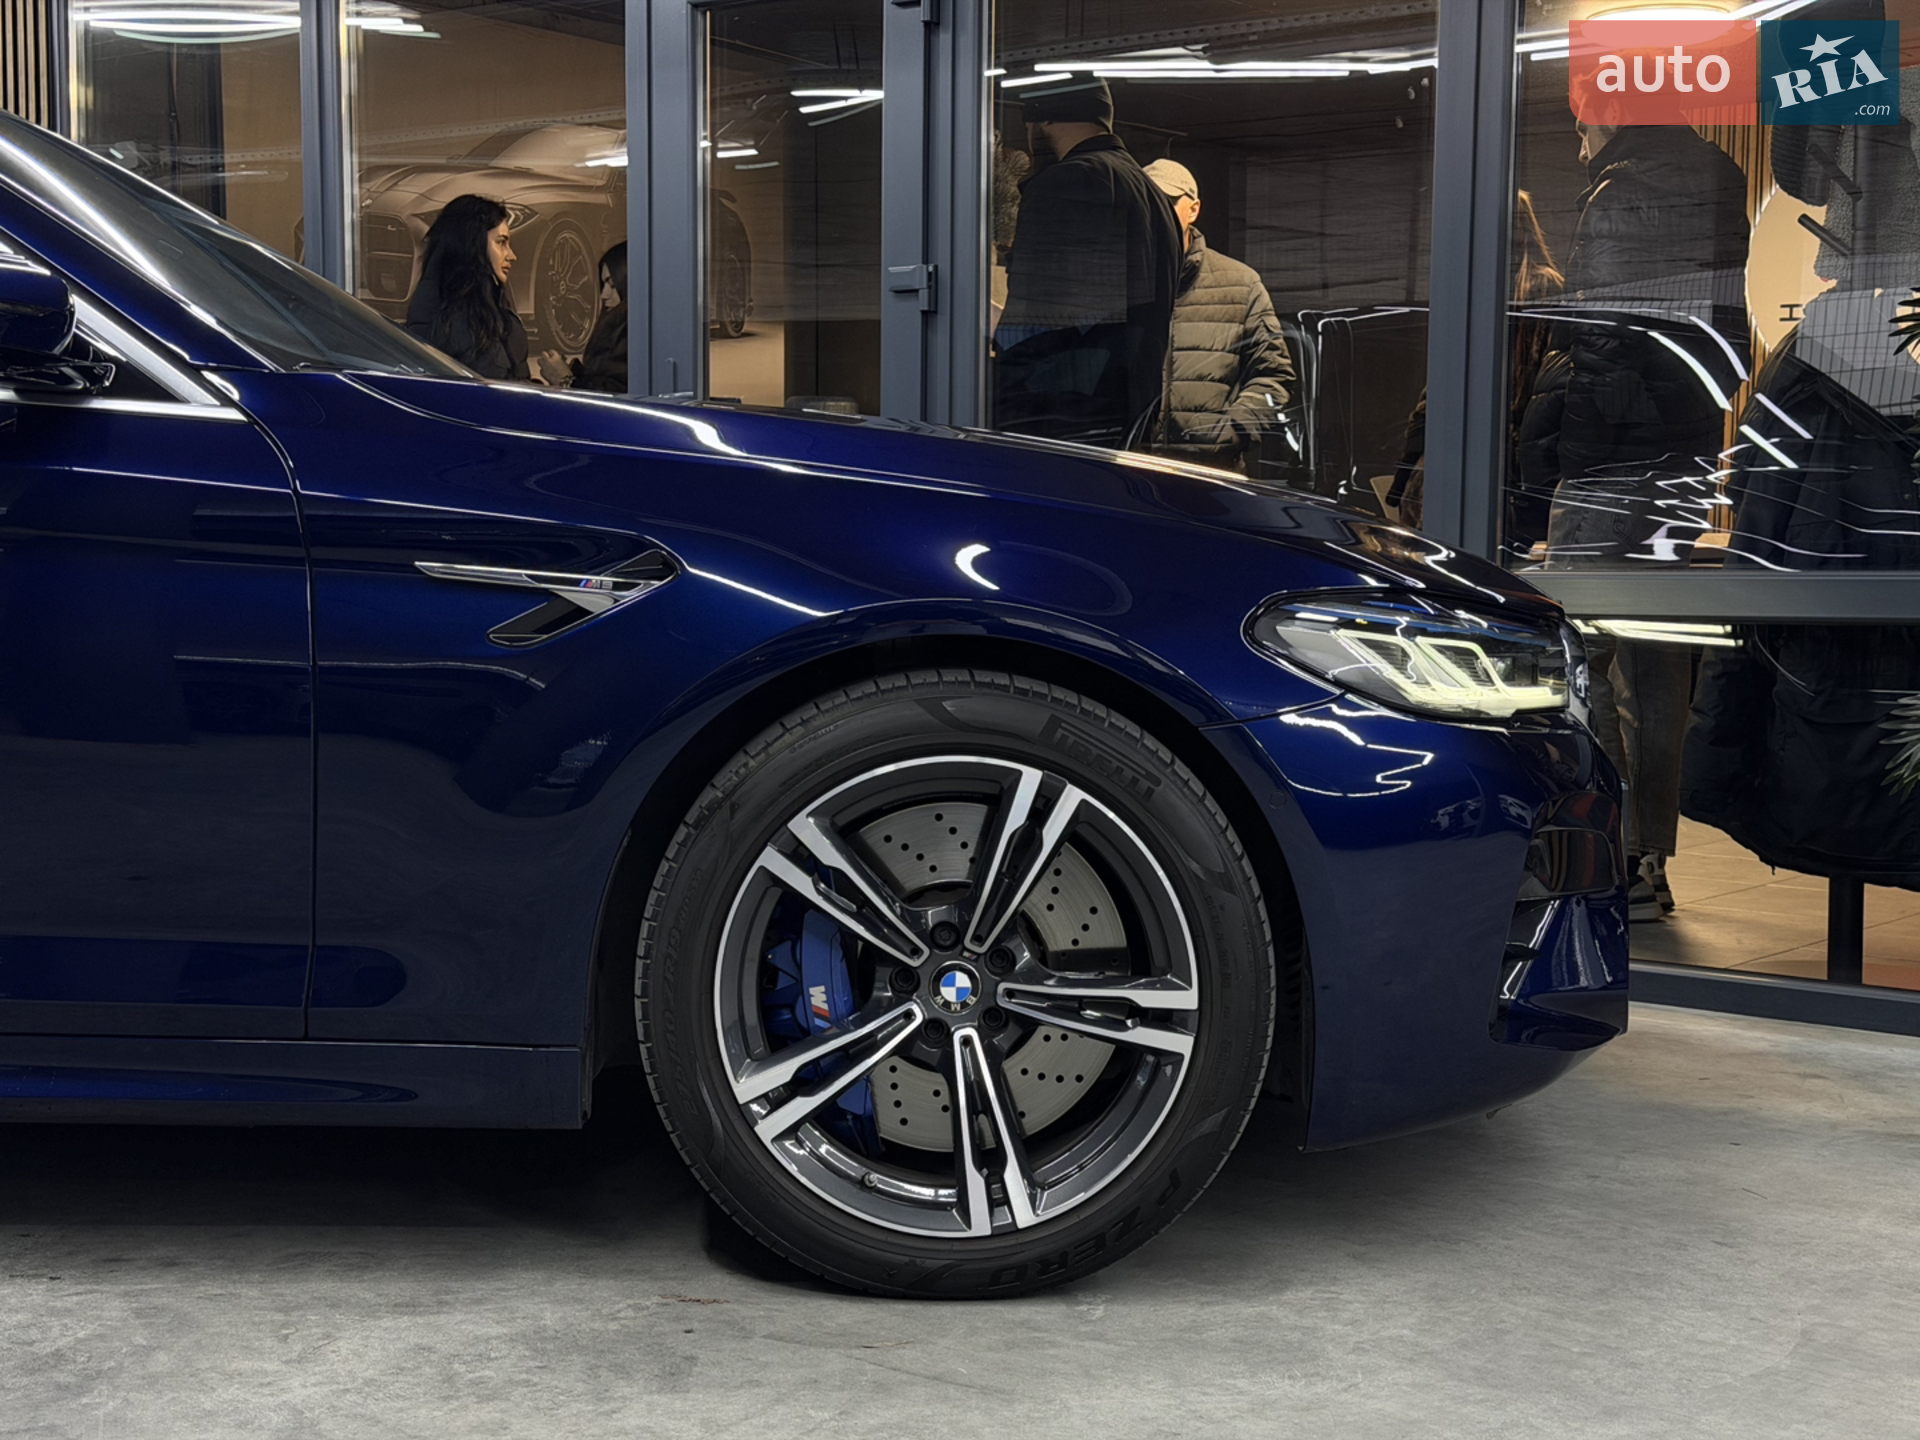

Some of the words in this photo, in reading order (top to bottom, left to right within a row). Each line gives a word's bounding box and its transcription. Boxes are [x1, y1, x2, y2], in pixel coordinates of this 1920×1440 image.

[1038, 713, 1162, 802] PIRELLI
[934, 995, 977, 1012] BMW
[987, 1206, 1144, 1290] ZERO
